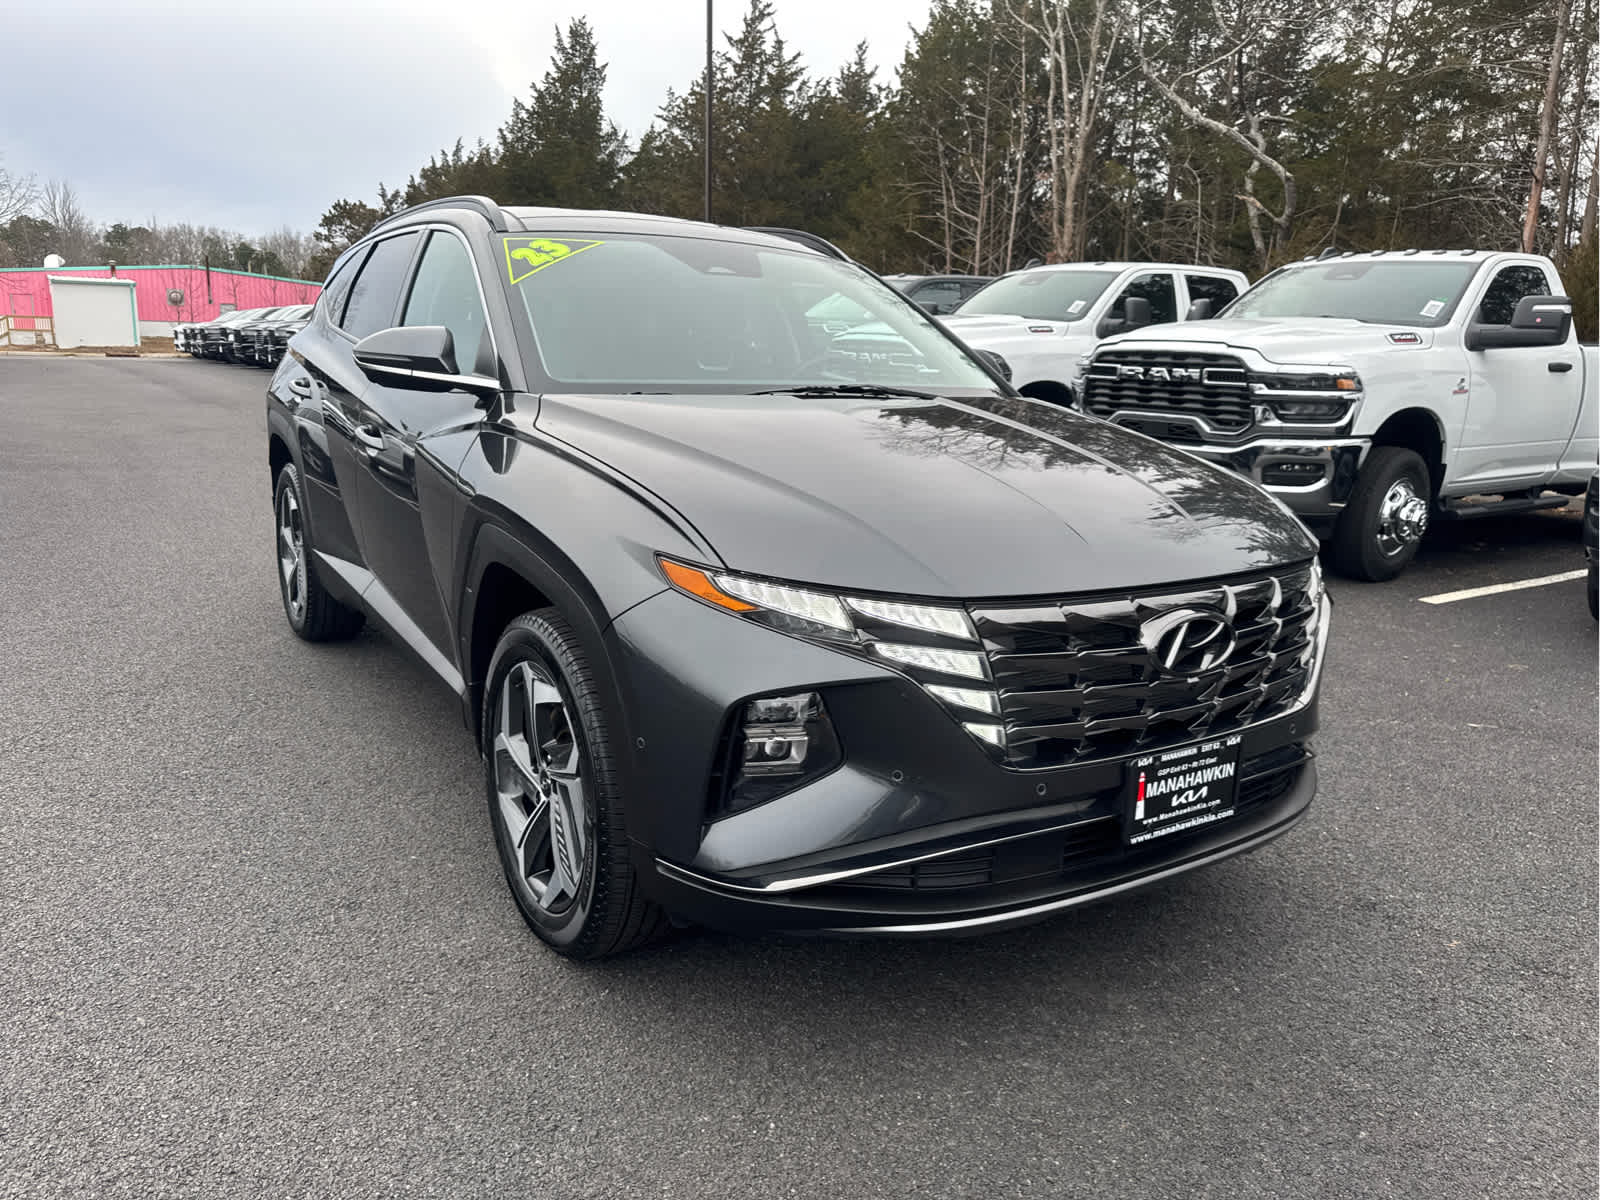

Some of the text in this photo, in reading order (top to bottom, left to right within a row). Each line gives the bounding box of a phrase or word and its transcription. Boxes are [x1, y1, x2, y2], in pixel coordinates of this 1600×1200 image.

[510, 239, 571, 267] 23
[1119, 365, 1201, 381] RAM
[1161, 747, 1198, 762] MANAHAWKIN
[1145, 761, 1235, 798] MANAHAWKIN
[1157, 767, 1170, 776] GSP
[1142, 799, 1221, 825] www.ManahawkinKia.com
[1129, 809, 1235, 844] www.manahawkinkia.com
